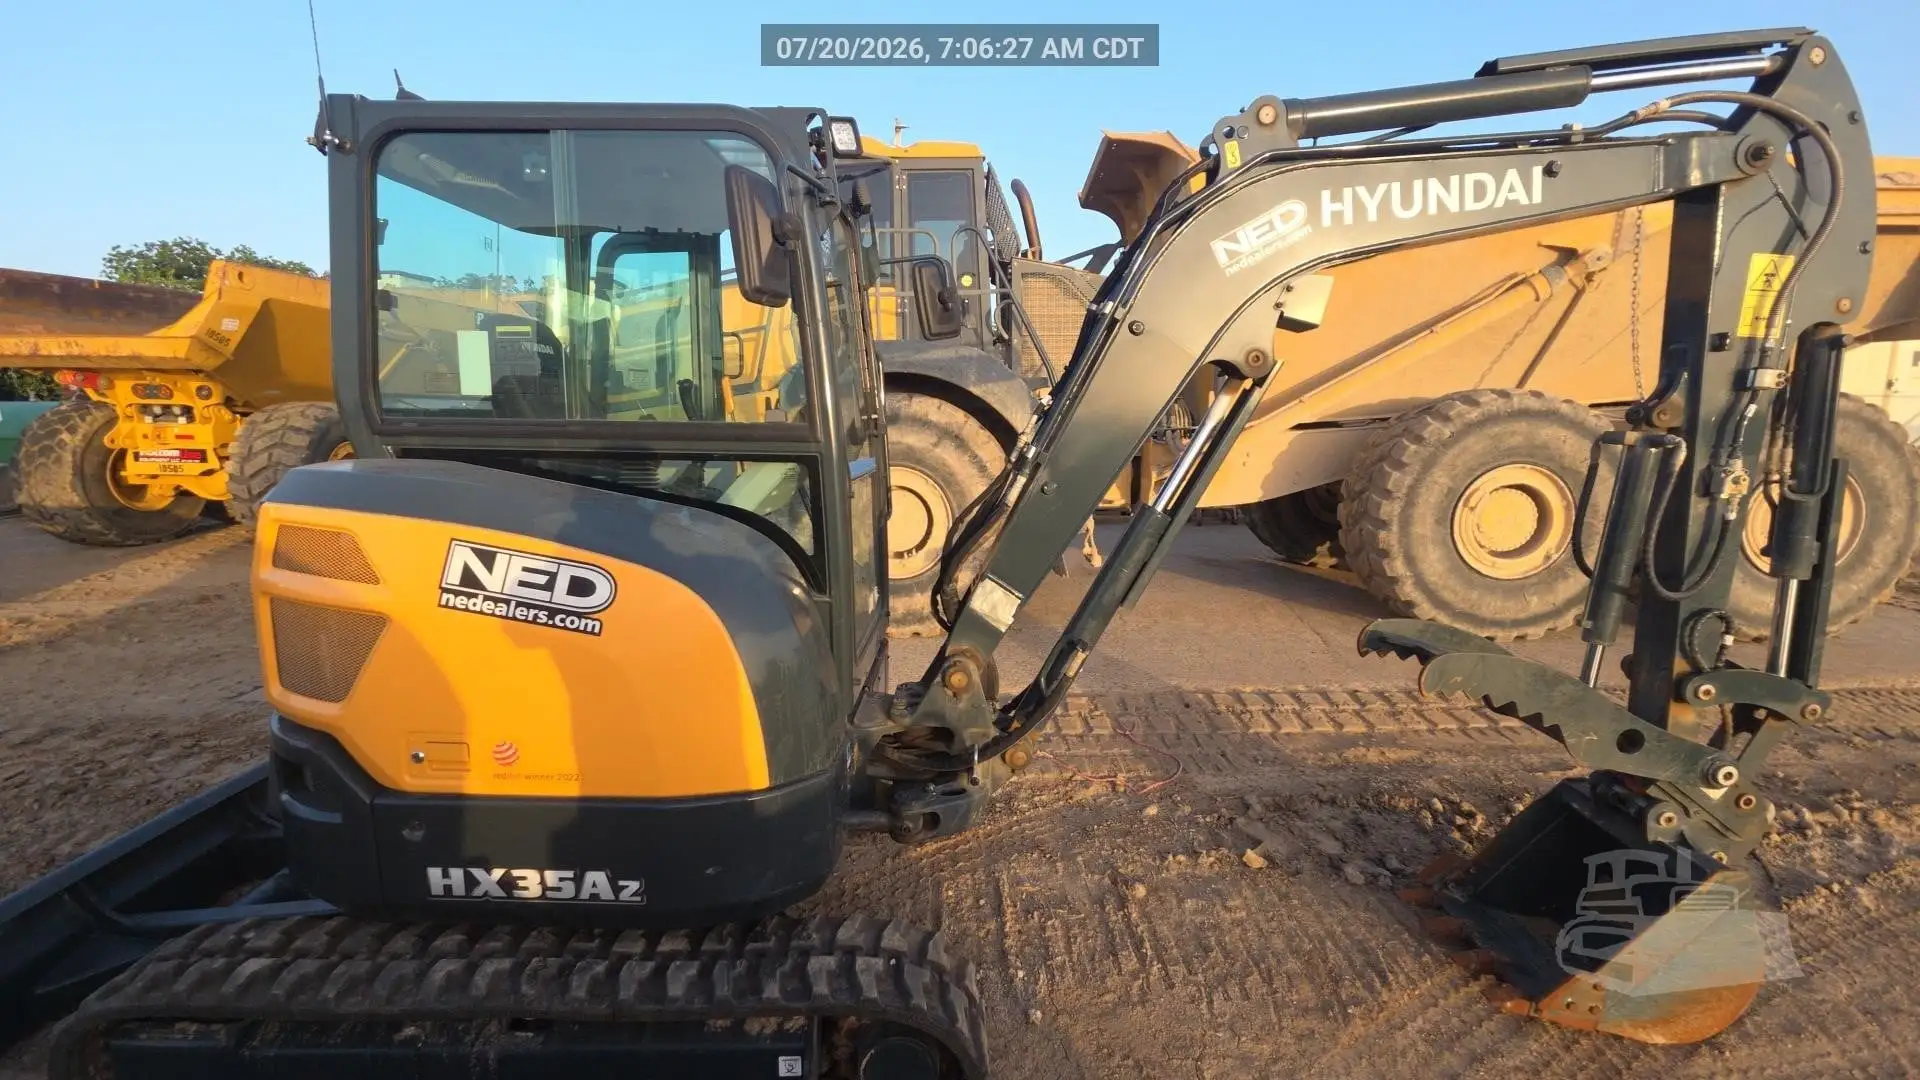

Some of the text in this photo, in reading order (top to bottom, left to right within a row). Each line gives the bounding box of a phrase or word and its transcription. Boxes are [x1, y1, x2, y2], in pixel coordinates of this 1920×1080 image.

[1321, 165, 1543, 228] HYUNDAI
[1211, 201, 1306, 267] NED
[445, 545, 612, 609] NED
[440, 591, 602, 634] nedealers.com
